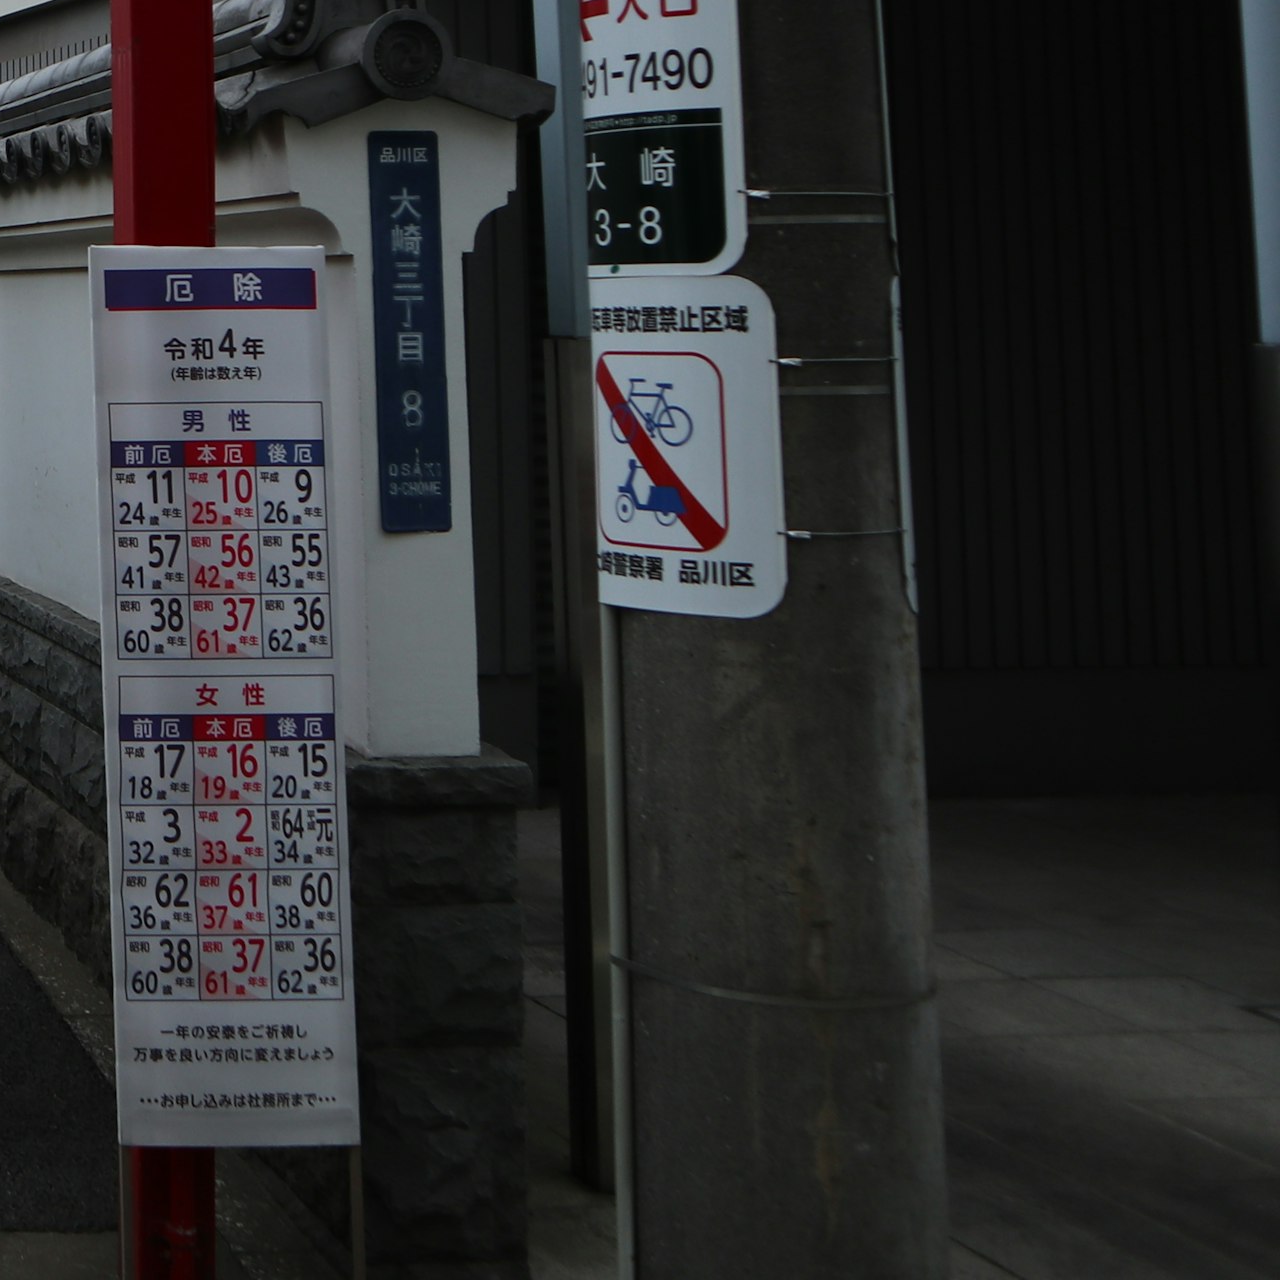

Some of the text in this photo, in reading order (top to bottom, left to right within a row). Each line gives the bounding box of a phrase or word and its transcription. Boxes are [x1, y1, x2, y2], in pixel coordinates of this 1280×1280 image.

[379, 146, 429, 164] 品川区
[586, 146, 676, 192] 大崎
[594, 205, 663, 247] 3-8
[165, 273, 262, 303] 厄除
[389, 187, 424, 364] 大崎三丁目
[163, 328, 265, 361] 令和4年
[182, 409, 251, 433] 男性
[124, 443, 312, 466] 前厄 本厄 後厄
[679, 558, 756, 587] 品川区
[196, 684, 265, 707] 女性
[132, 717, 323, 738] 前厄 本厄 後厄
[133, 1047, 335, 1062] 万事を良い方向に変えましょう
